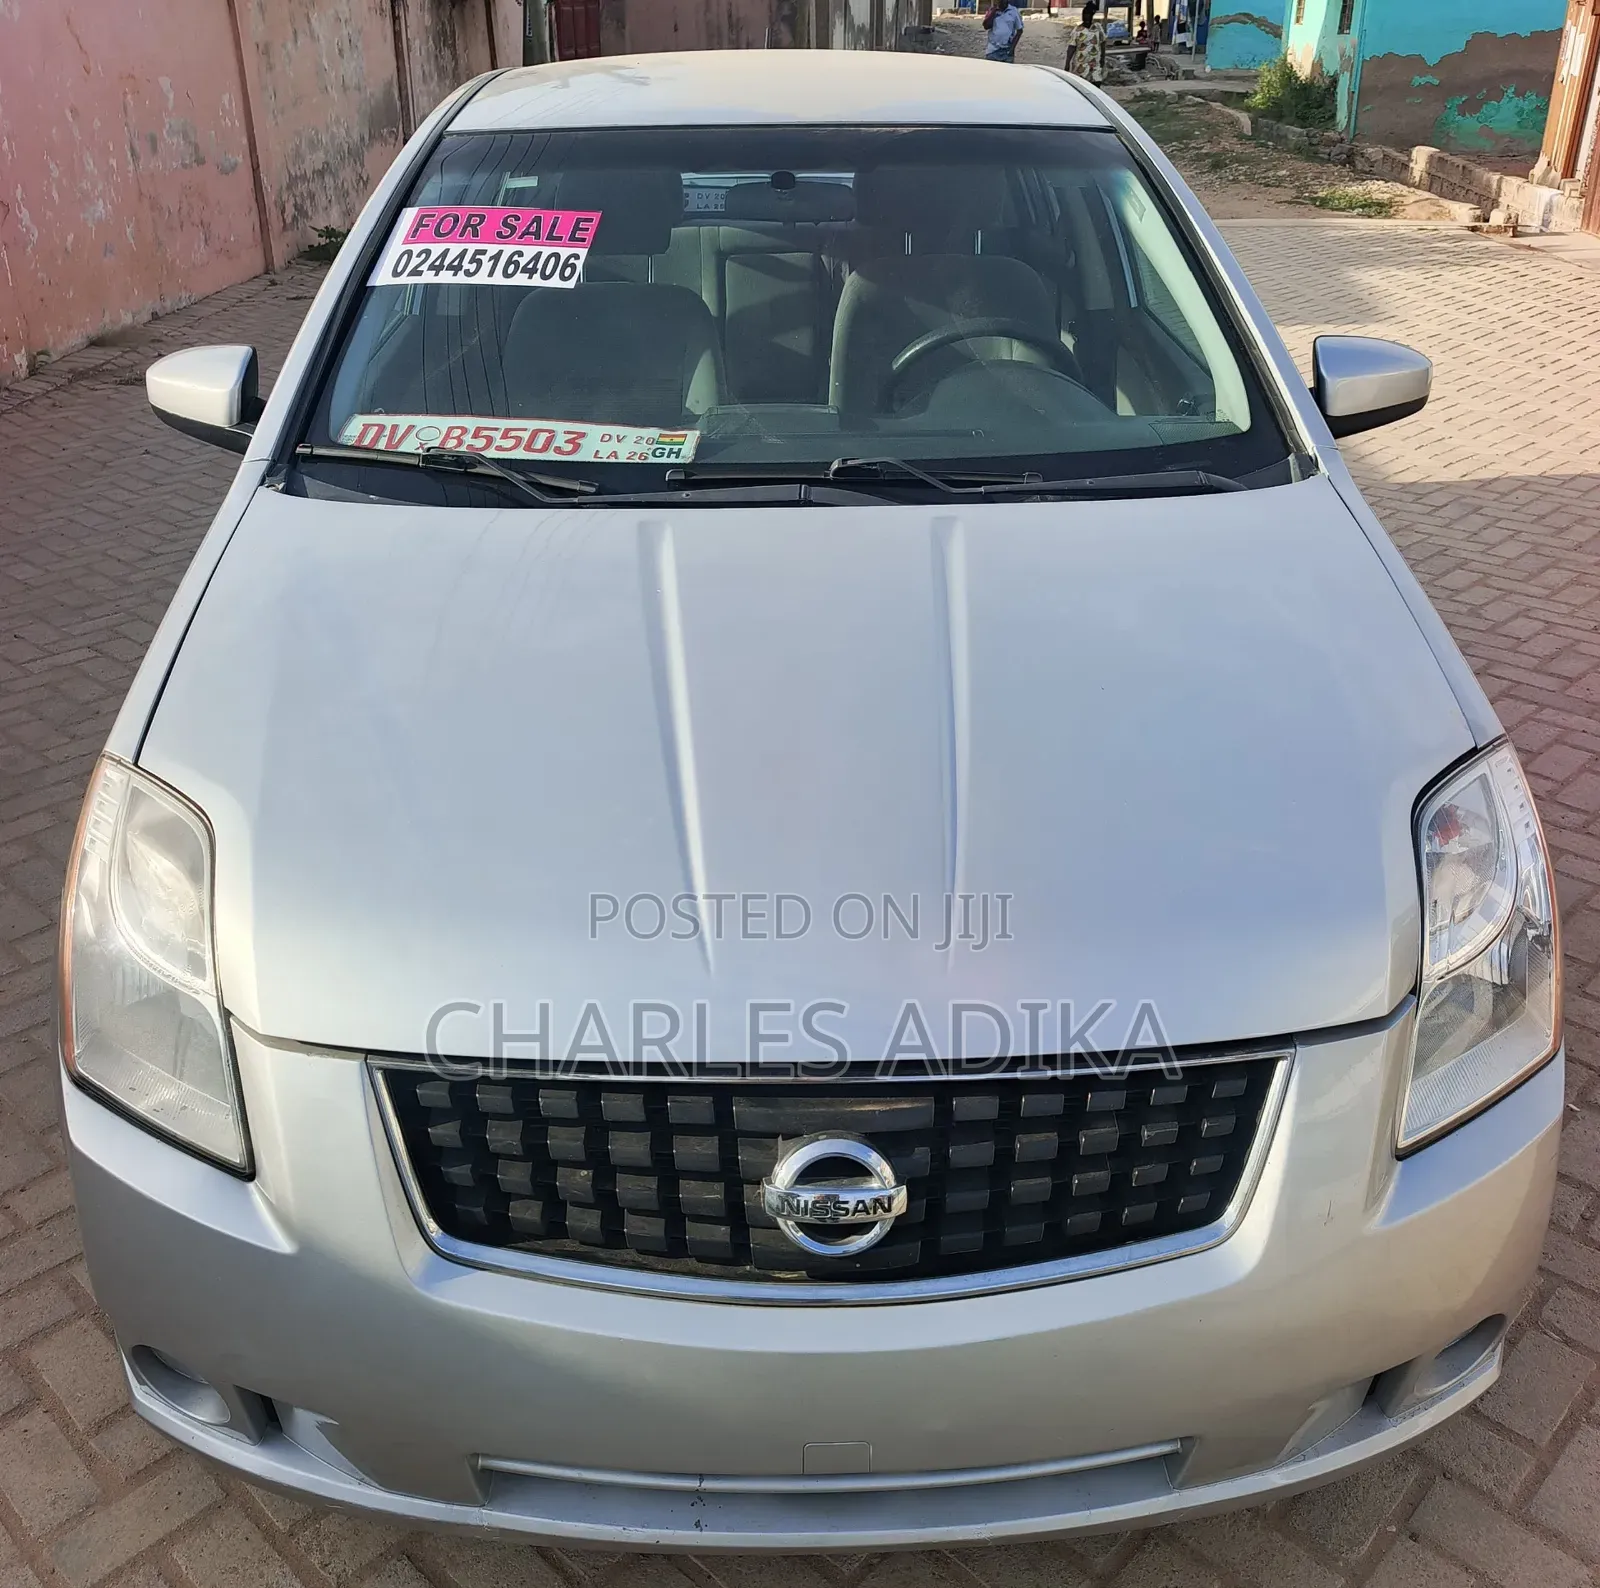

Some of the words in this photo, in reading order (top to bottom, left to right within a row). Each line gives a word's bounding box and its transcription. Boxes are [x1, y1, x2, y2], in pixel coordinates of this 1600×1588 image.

[696, 192, 711, 200] DV
[409, 212, 488, 240] FOR
[495, 213, 596, 243] SALE
[391, 248, 581, 283] 0244516406
[353, 423, 416, 450] DV
[437, 425, 587, 456] B5503
[599, 433, 628, 444] DV
[633, 435, 656, 446] 20
[593, 449, 620, 460] LA
[626, 450, 650, 461] 26
[651, 446, 684, 459] GH
[779, 1196, 893, 1218] NISSAN
